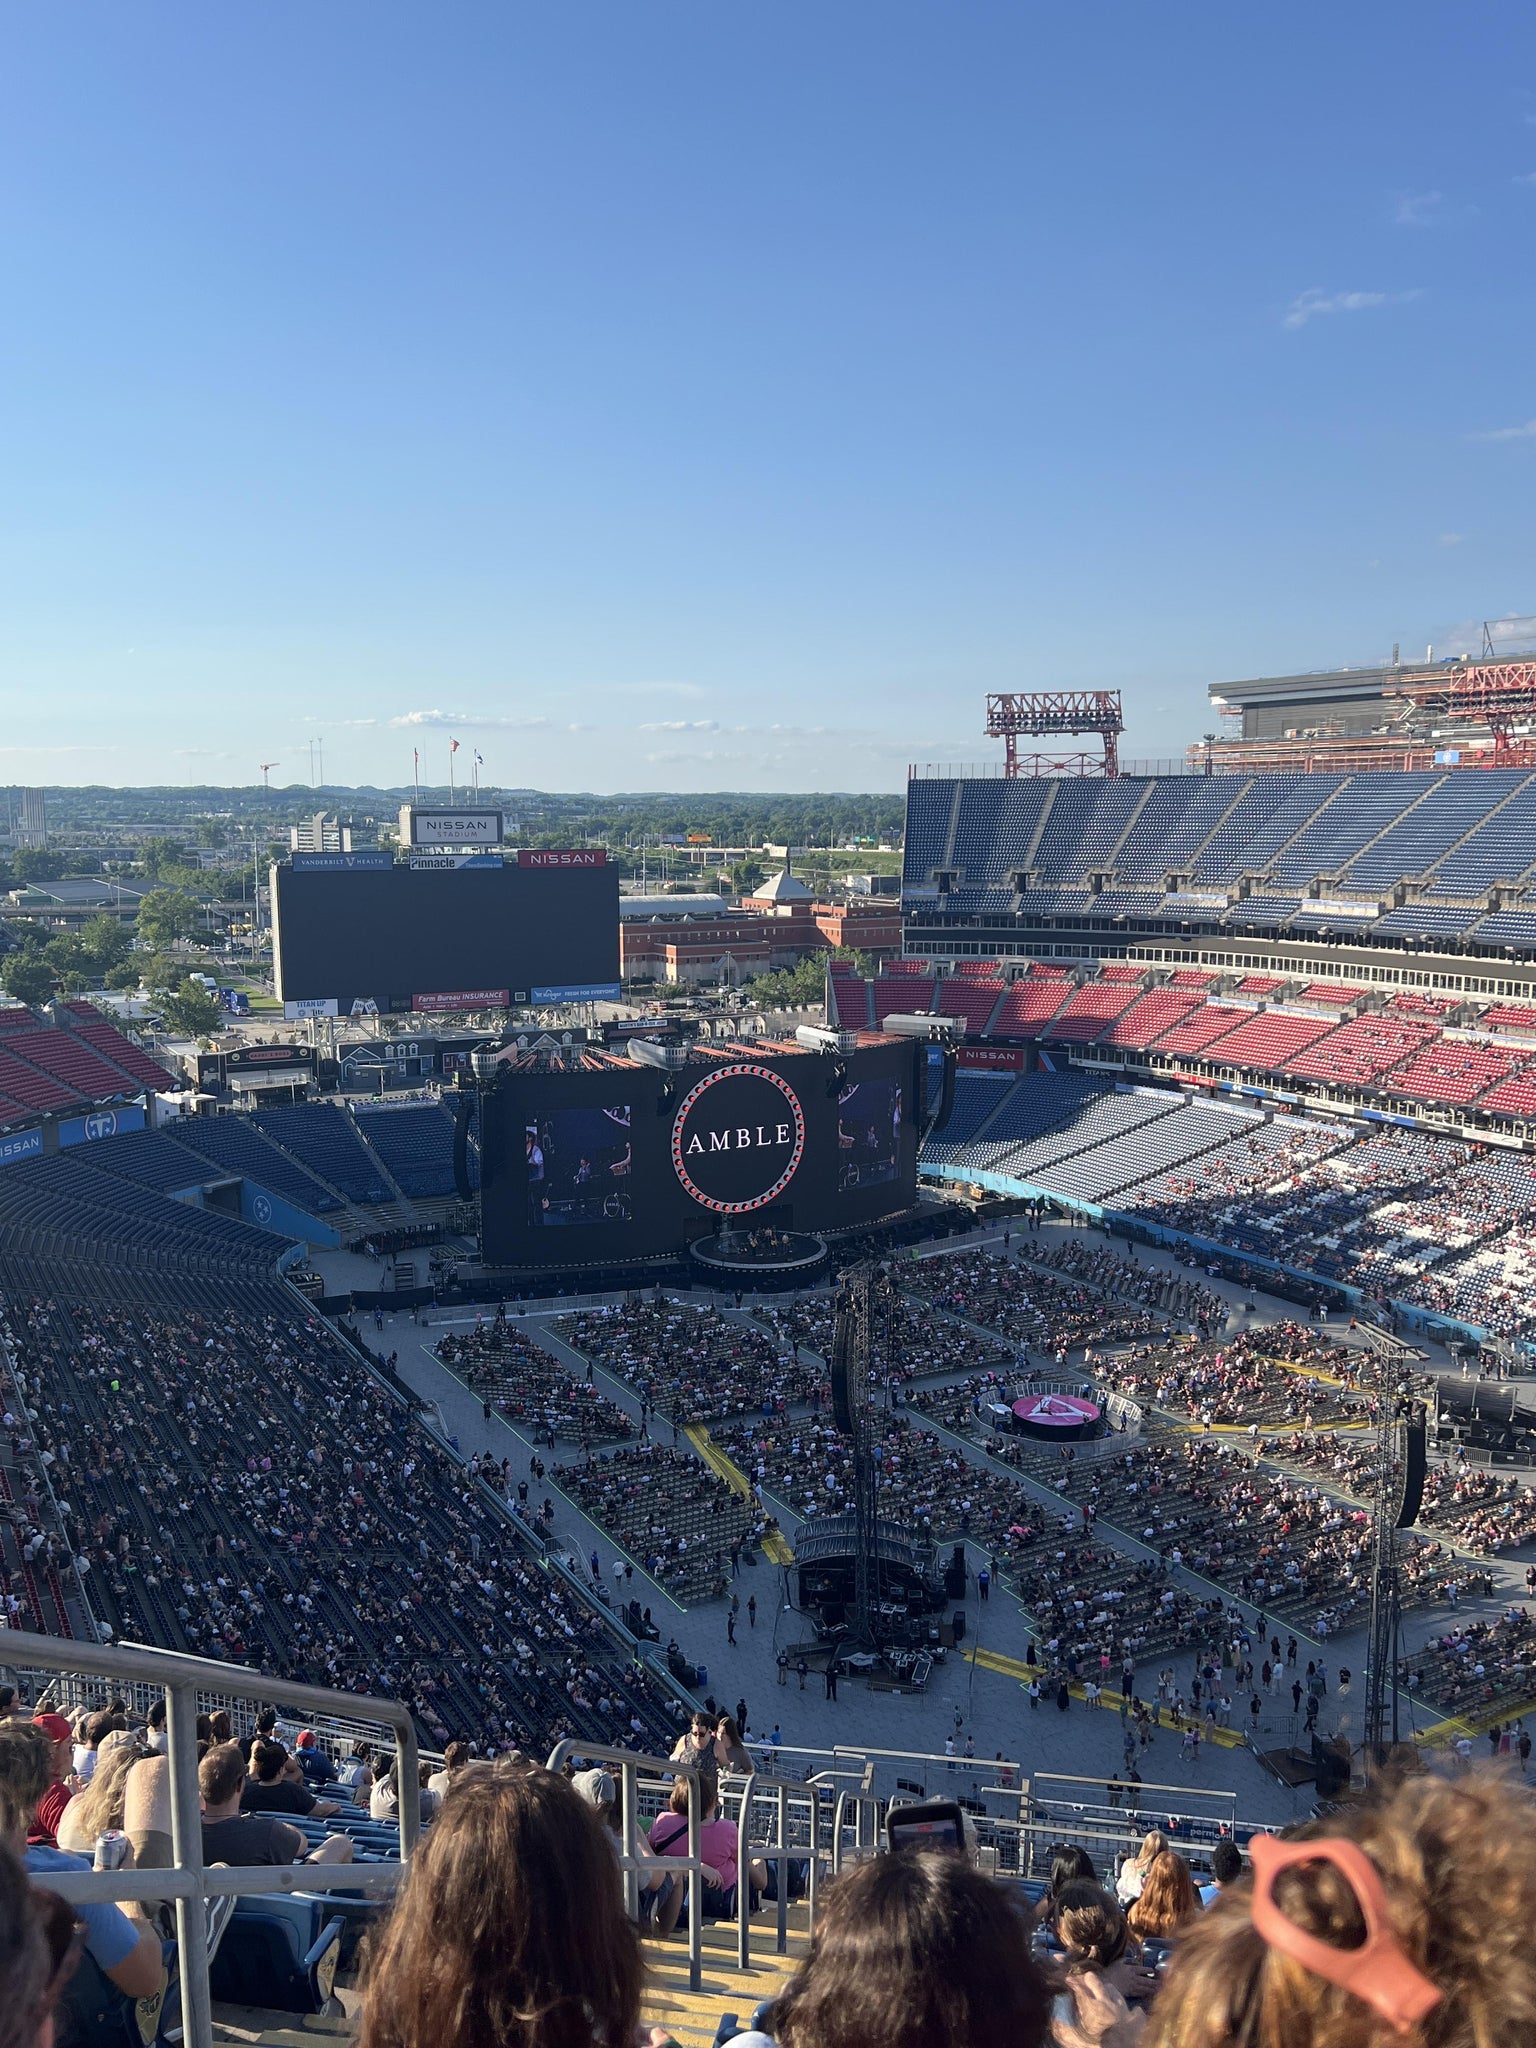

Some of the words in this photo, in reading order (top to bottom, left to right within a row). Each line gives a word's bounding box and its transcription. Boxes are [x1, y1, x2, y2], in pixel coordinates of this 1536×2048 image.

[426, 821, 487, 830] NISSAN
[356, 858, 384, 866] HEALTH
[411, 857, 455, 869] Pinnacle
[530, 854, 595, 864] NISSAN
[418, 995, 436, 1003] Farm
[437, 994, 461, 1002] Bureau
[462, 991, 504, 1000] INSURANCE
[966, 1051, 1015, 1061] NISSAN
[686, 1123, 790, 1155] AMBLE
